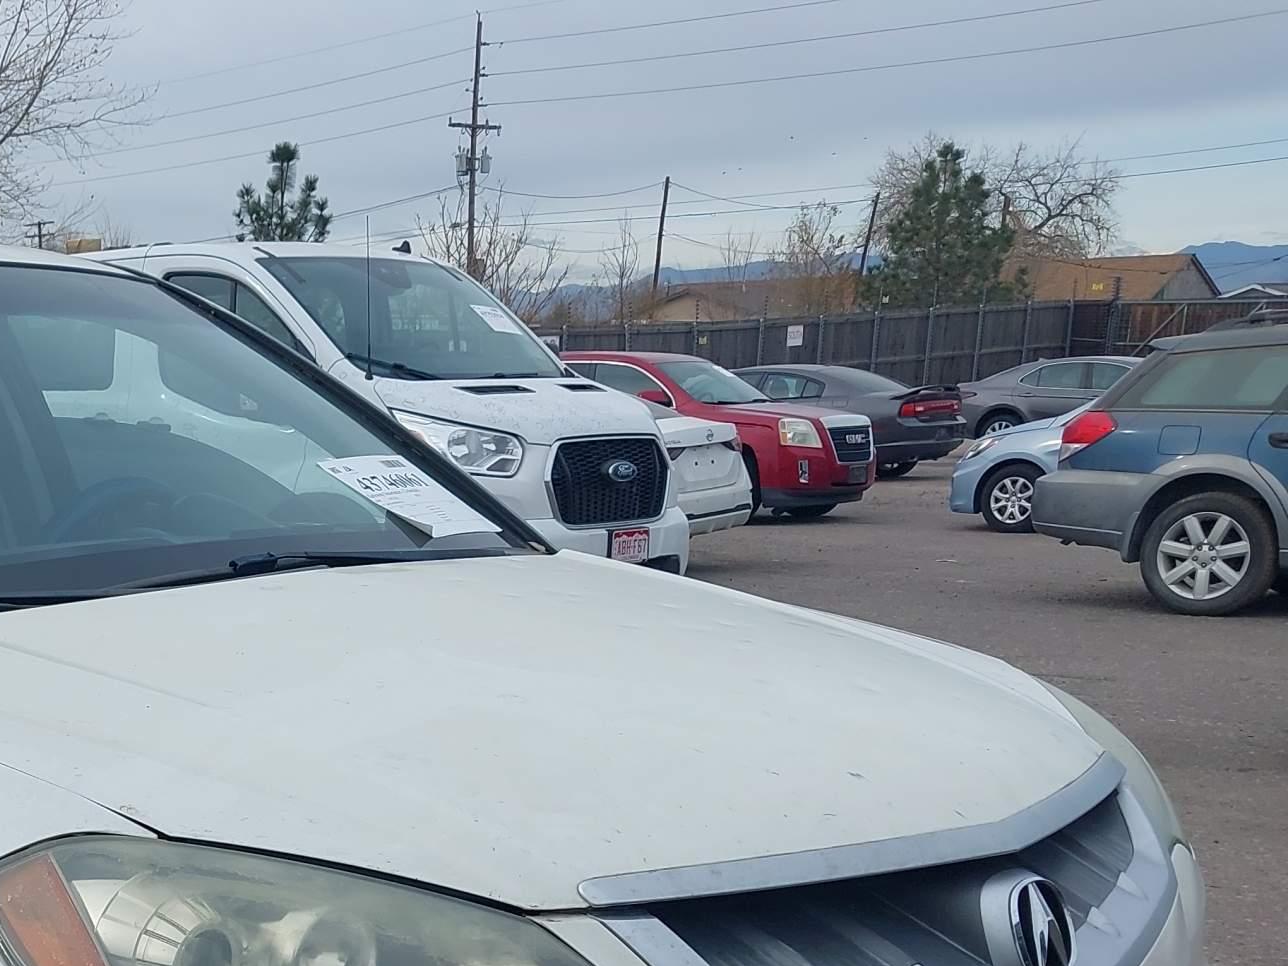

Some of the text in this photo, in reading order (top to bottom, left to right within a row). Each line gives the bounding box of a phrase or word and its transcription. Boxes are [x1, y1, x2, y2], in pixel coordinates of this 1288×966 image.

[845, 433, 867, 445] GMC
[617, 464, 634, 477] Ford
[356, 472, 429, 492] 43746061
